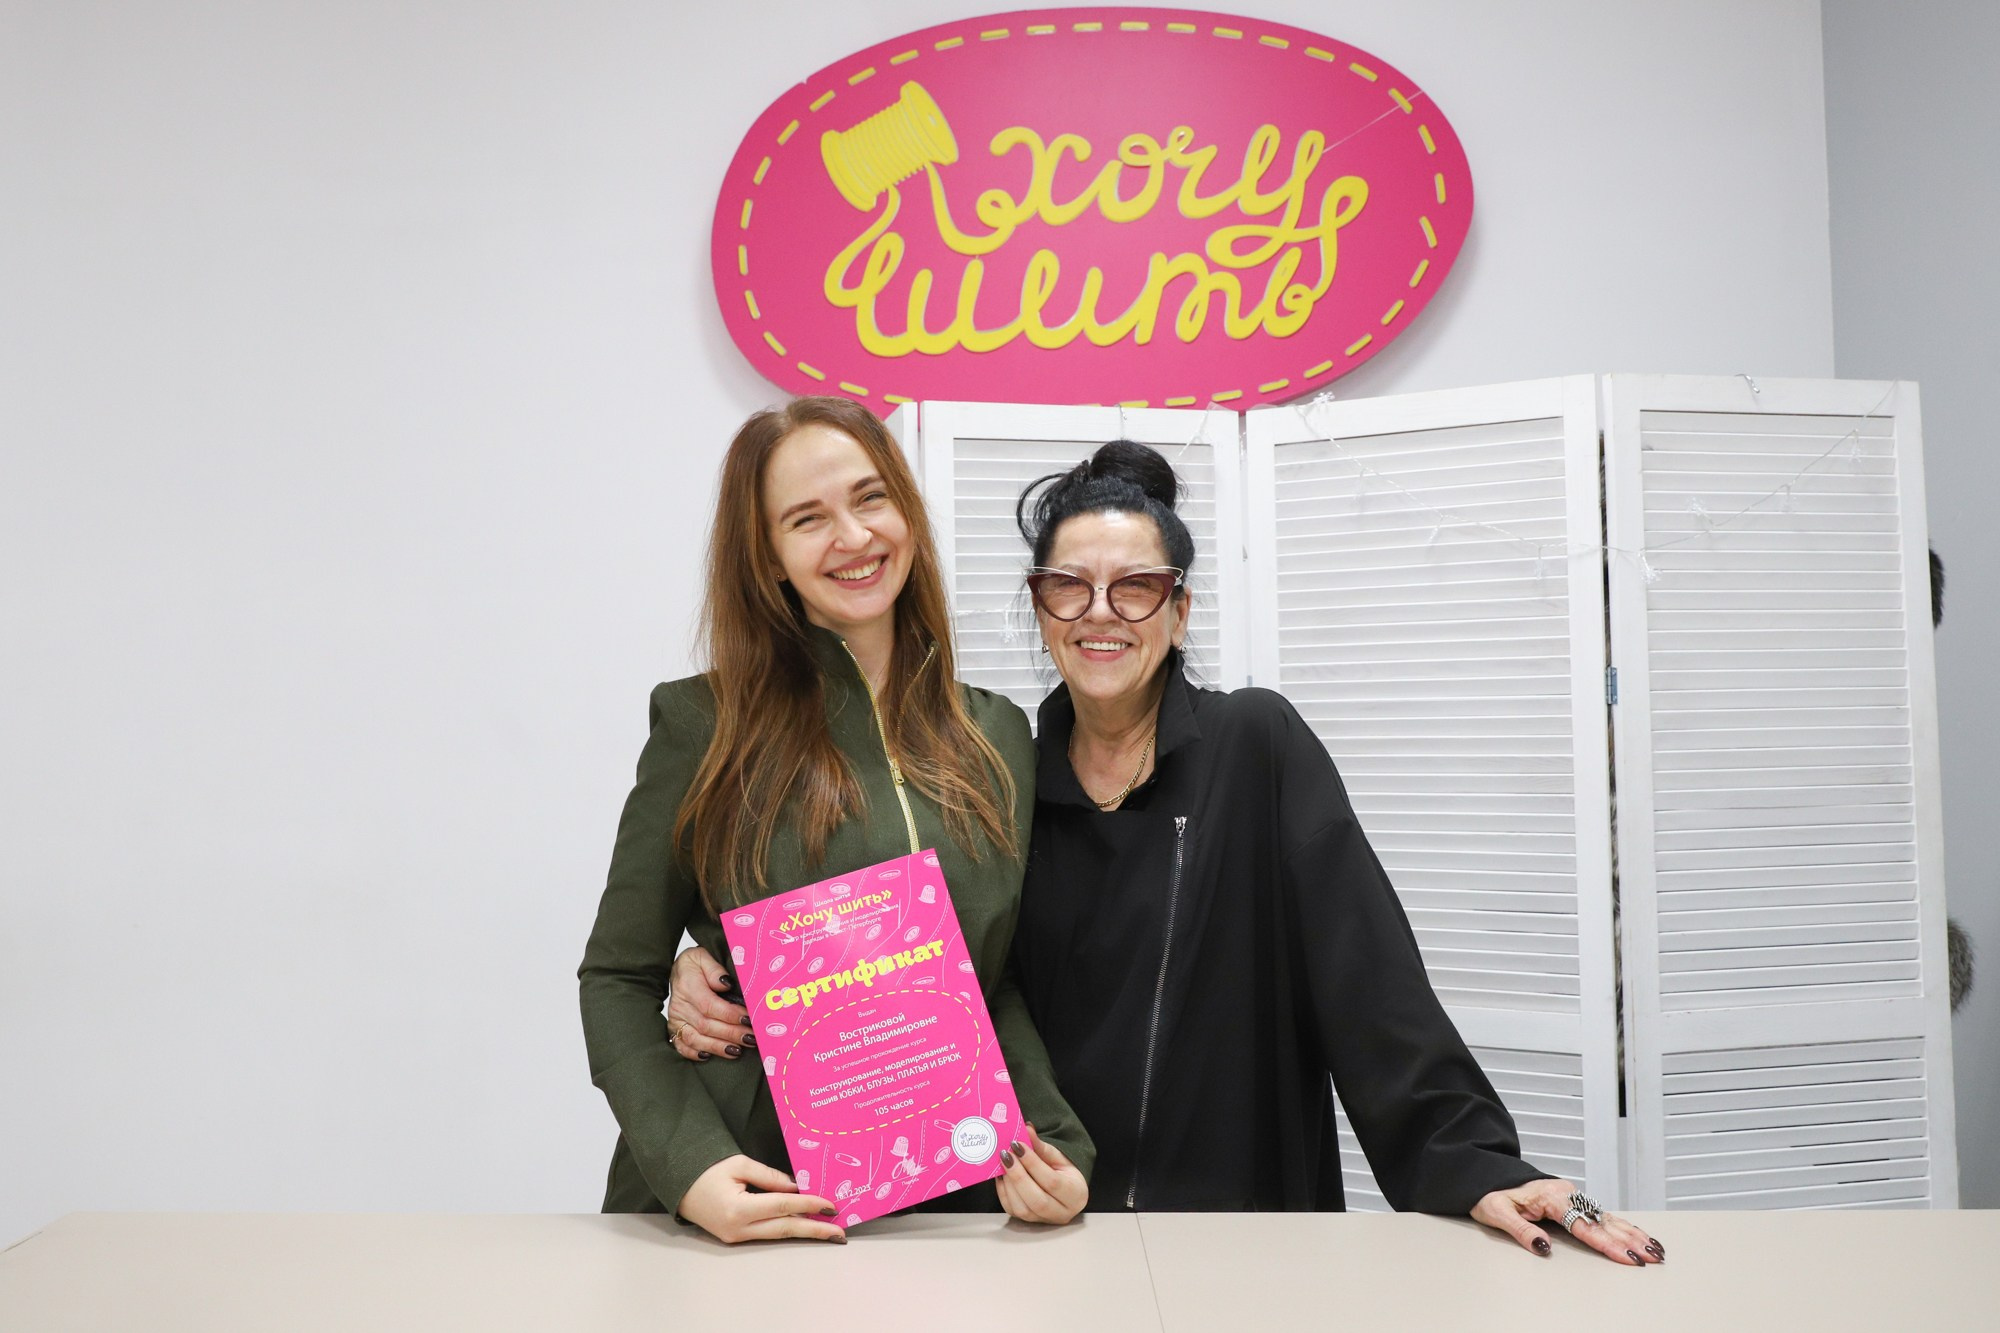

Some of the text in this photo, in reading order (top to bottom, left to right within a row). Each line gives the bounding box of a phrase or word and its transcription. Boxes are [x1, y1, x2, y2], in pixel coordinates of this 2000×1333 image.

[779, 889, 892, 933] «Хочу шить»
[765, 938, 945, 1011] Сертификат
[839, 1012, 906, 1042] Востриковой
[857, 1008, 877, 1018] Выдан
[813, 1014, 938, 1064] Кристине Владимировне
[841, 1056, 870, 1071] успешное
[870, 1043, 910, 1060] прохождение
[910, 1037, 927, 1048] курса
[809, 1066, 884, 1097] Конструирование,
[884, 1046, 949, 1072] моделирование
[811, 1052, 962, 1109] пошив ЮБКИ, БЛУЗЫ, ПЛАТЬЯ И БРЮК
[854, 1080, 931, 1110] Продолжительность курса
[874, 1098, 914, 1116] 105 часов
